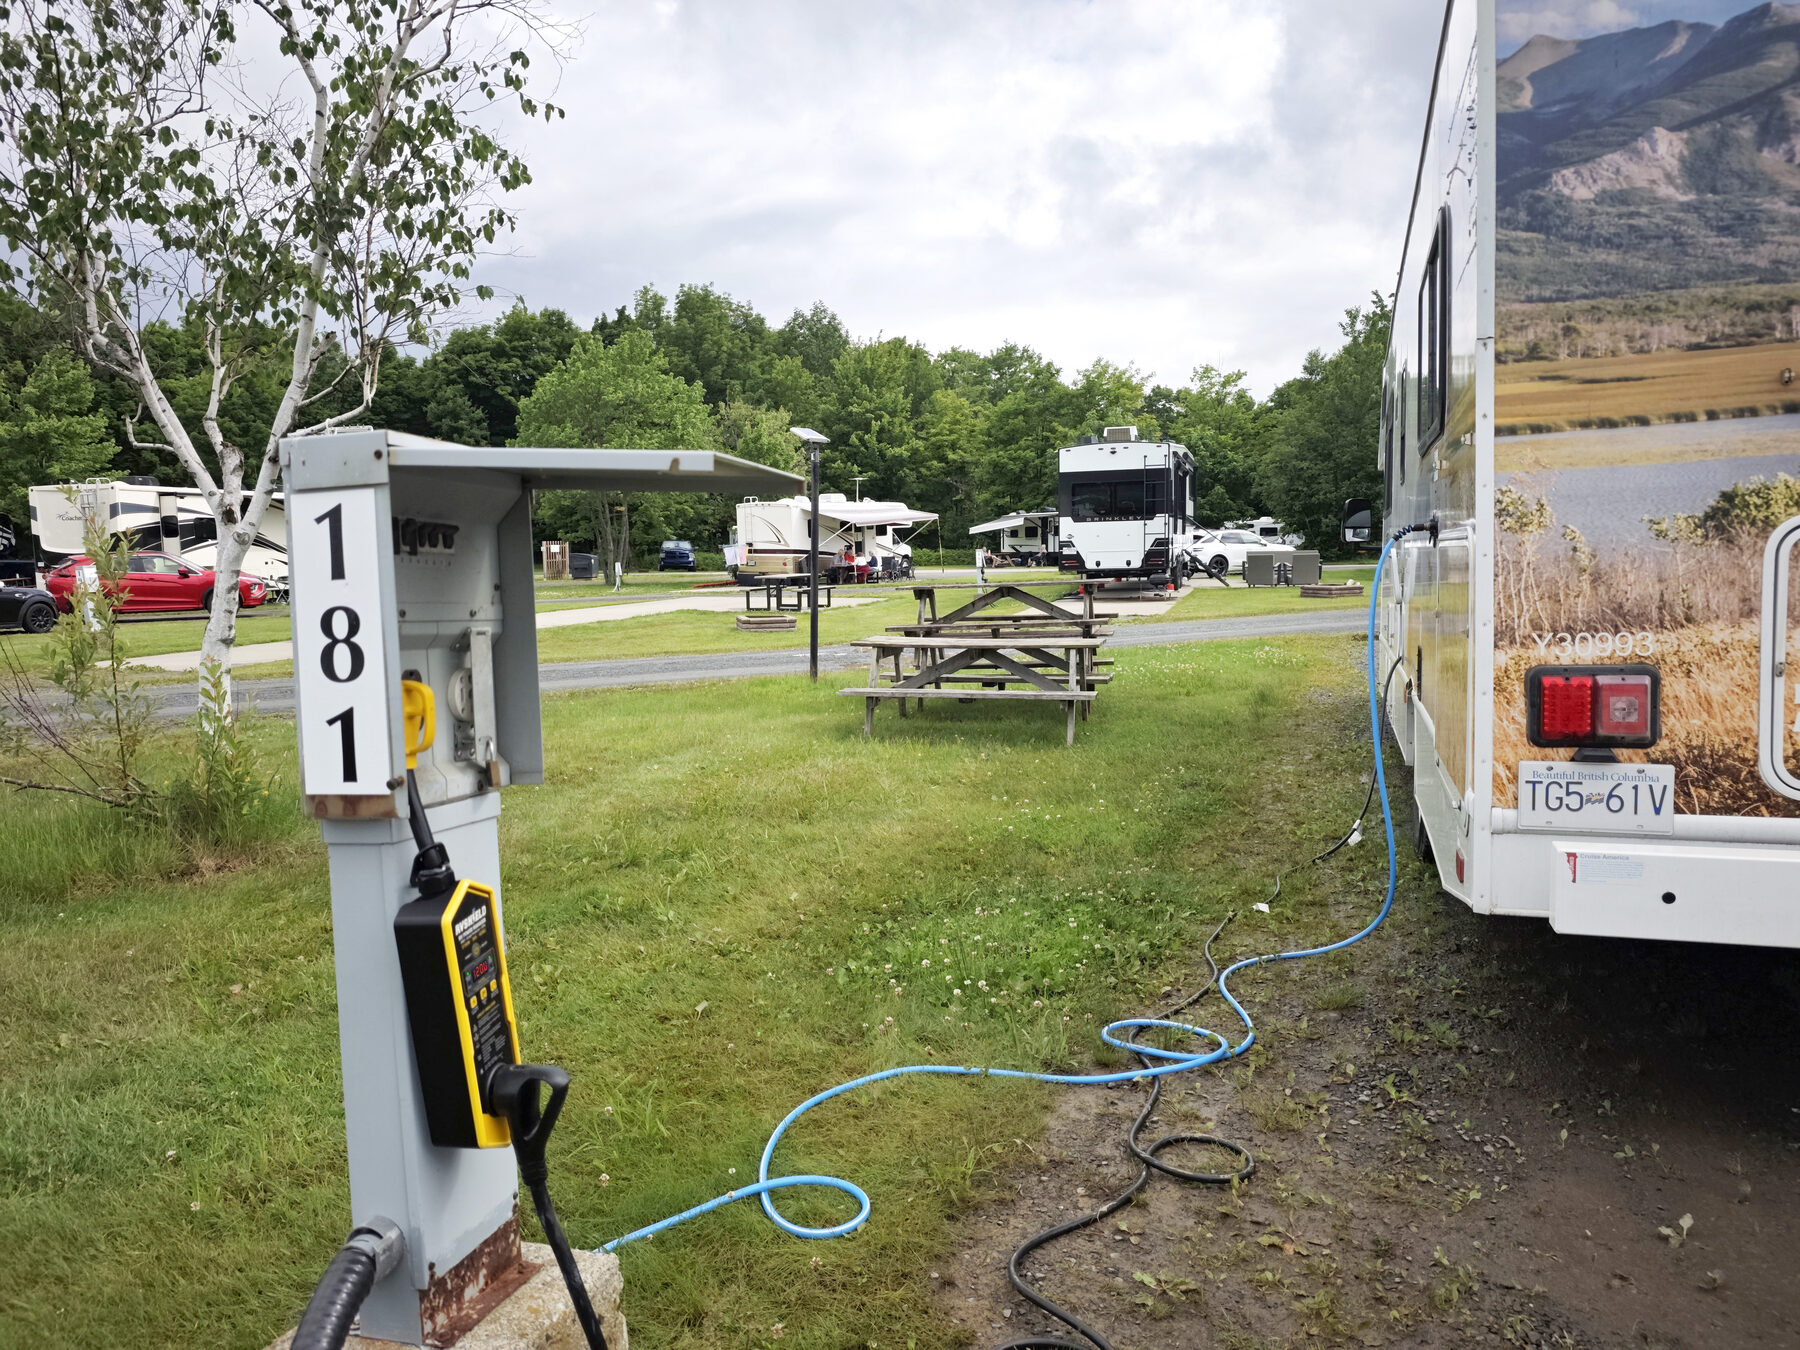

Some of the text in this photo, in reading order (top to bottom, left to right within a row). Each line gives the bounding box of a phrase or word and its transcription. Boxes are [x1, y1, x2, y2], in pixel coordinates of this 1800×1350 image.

[314, 502, 365, 783] 181
[1531, 631, 1654, 657] Y30993
[1532, 770, 1660, 783] Beautiful British Columbia
[1525, 780, 1668, 816] TG5 61V
